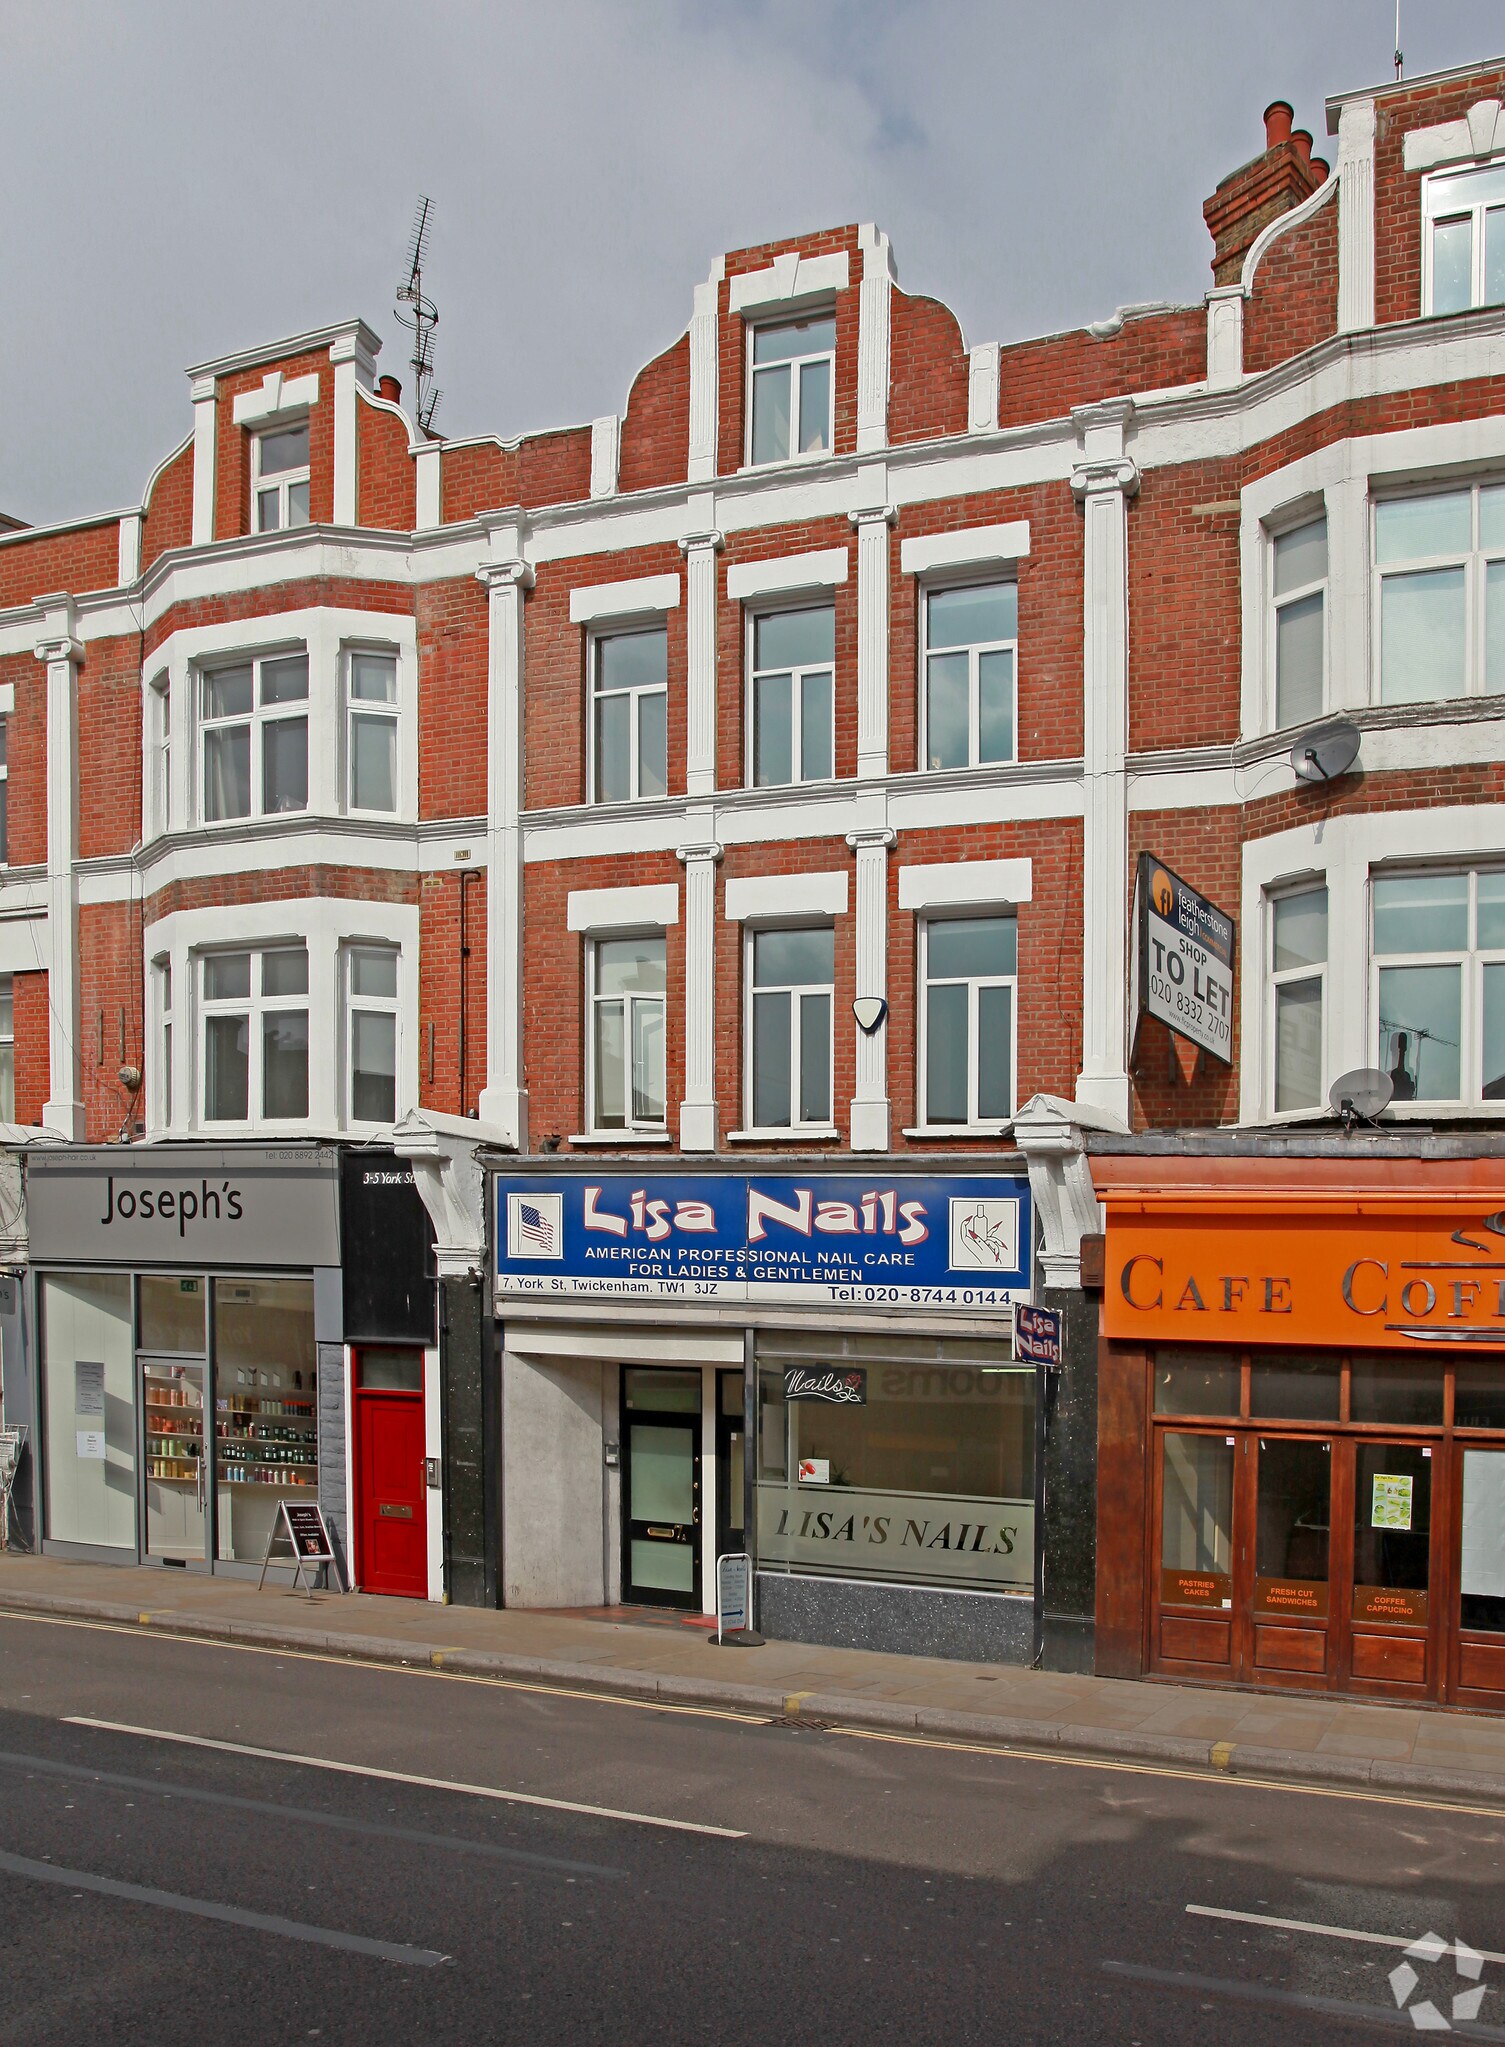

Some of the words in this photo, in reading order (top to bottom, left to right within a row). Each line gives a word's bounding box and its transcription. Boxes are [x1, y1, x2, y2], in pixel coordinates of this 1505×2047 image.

[1178, 888, 1228, 941] featherstone
[1179, 906, 1200, 937] leigh
[1179, 937, 1207, 966] SHOP
[1152, 937, 1185, 986] TO
[1193, 966, 1230, 1018] LET
[1151, 974, 1172, 1004] 020
[1177, 992, 1203, 1024] 8332
[1208, 1012, 1230, 1042] 2707
[265, 1152, 277, 1160] Tel:
[279, 1151, 293, 1160] 020
[294, 1151, 313, 1160] 8892
[314, 1151, 333, 1160] 2442
[363, 1172, 380, 1184] 3-5
[381, 1172, 402, 1184] York
[101, 1176, 243, 1238] Joseph's
[583, 1185, 718, 1242] Lisa
[747, 1188, 929, 1246] Nails
[584, 1247, 671, 1260] AMERICAN
[678, 1248, 811, 1264] PROFESSIONAL
[818, 1252, 858, 1265] NAIL
[864, 1253, 915, 1266] CARE
[629, 1263, 663, 1276] FOR
[668, 1264, 729, 1278] LADIES
[735, 1266, 747, 1279] &
[753, 1266, 862, 1281] GENTLEMEN
[503, 1278, 513, 1290] 7,
[517, 1278, 544, 1290] York
[551, 1278, 567, 1292] St,
[572, 1279, 653, 1293] Twickenham.
[658, 1281, 685, 1294] TW1
[694, 1282, 718, 1295] 3JZ
[1121, 1253, 1293, 1313] CAFE
[963, 1289, 1011, 1305] 0144
[1020, 1308, 1056, 1337] Lisa
[1016, 1334, 1060, 1364] Nails
[784, 1369, 842, 1393] Nails
[774, 1509, 892, 1545] LISA'S
[900, 1519, 1019, 1555] NAILS
[1179, 1579, 1215, 1589] PASTRIES
[1183, 1588, 1210, 1597] CAKES
[1270, 1587, 1296, 1597] FRESH
[1297, 1589, 1313, 1598] CUT
[1266, 1595, 1318, 1607] SANDWICHES
[1366, 1604, 1413, 1615] CAPPUCINO
[1374, 1596, 1406, 1606] COFFEE
